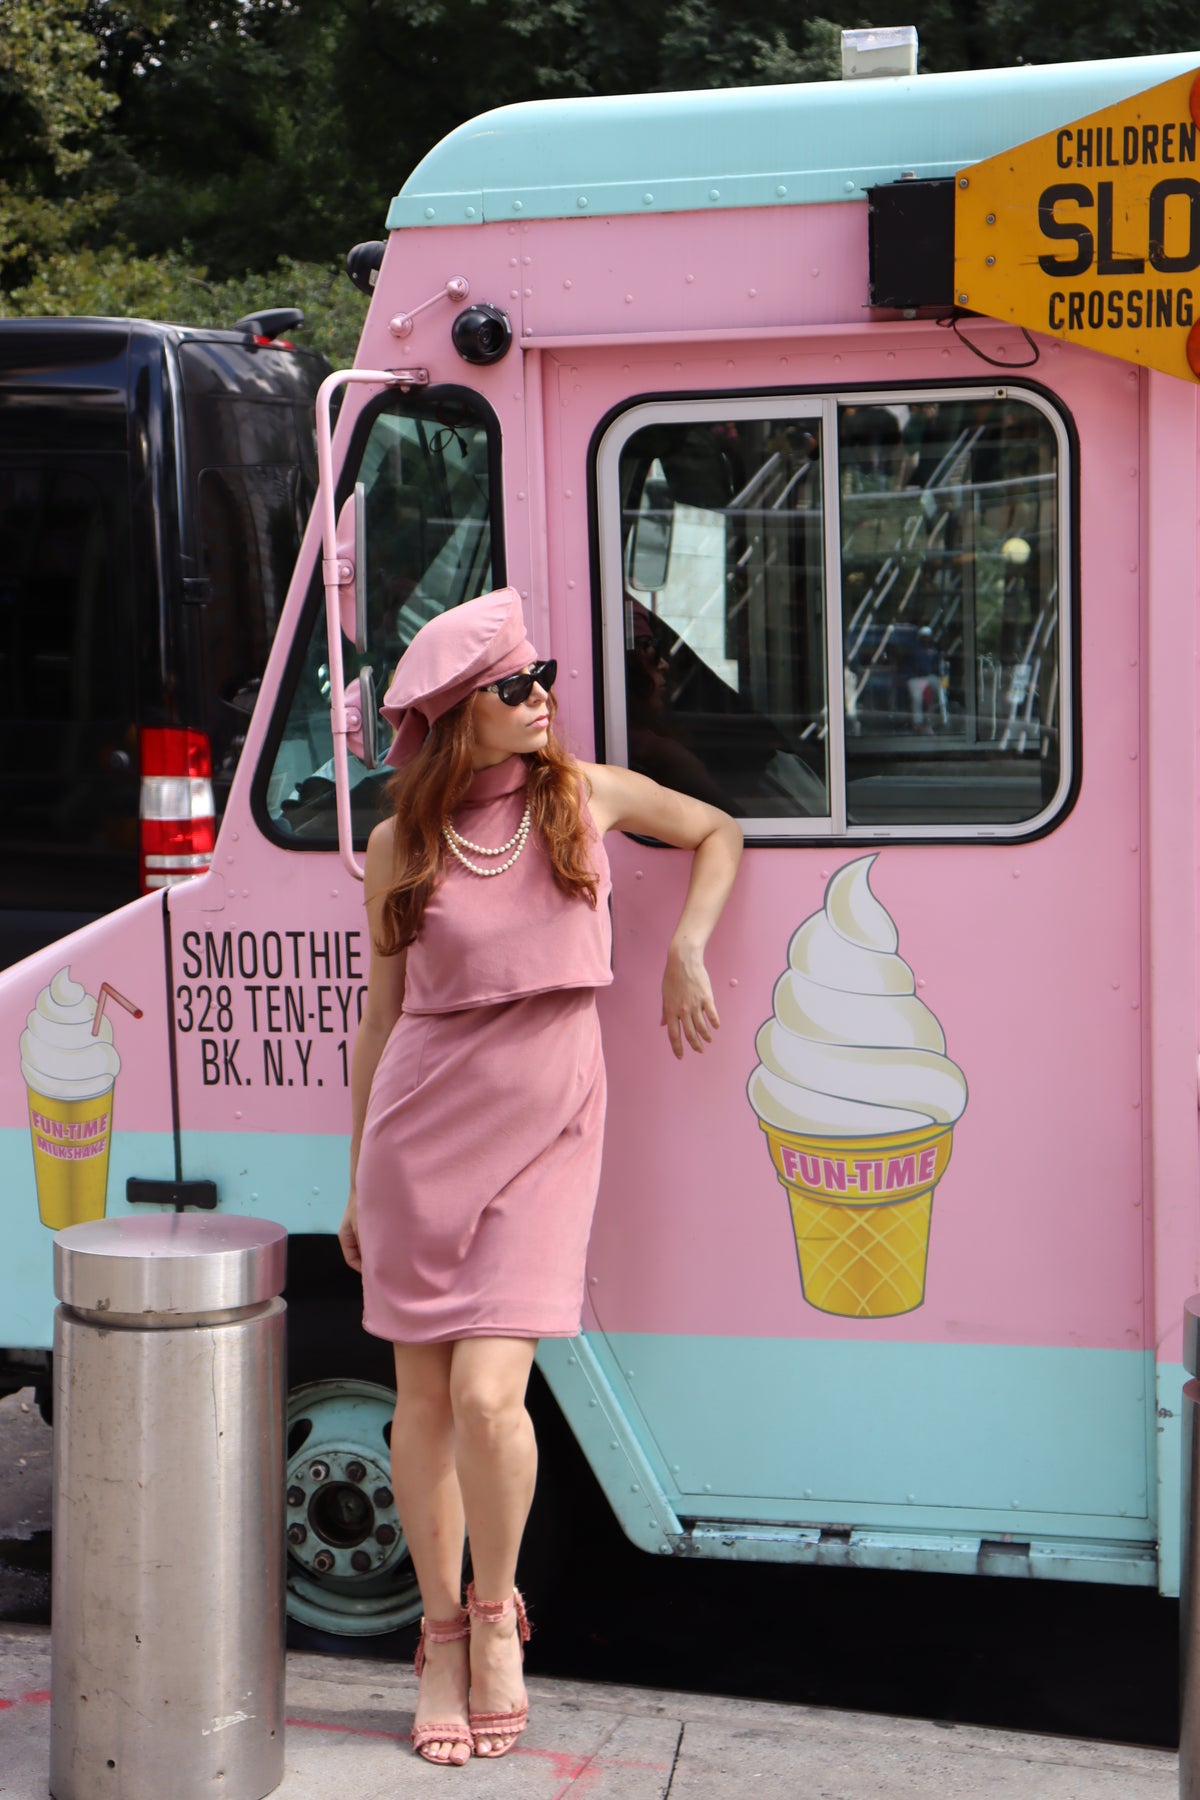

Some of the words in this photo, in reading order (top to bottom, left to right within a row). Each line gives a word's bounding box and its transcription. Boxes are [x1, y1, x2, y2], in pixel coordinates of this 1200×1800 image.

[1056, 122, 1196, 169] CHILDREN
[1037, 177, 1200, 278] SLO
[1048, 288, 1194, 330] CROSSING
[182, 930, 363, 979] SMOOTHIE
[176, 985, 234, 1032] 328
[201, 1038, 252, 1086] BK.
[263, 1039, 323, 1087] N.Y.
[31, 1109, 108, 1141] FUN-TIME
[36, 1134, 107, 1160] MILKSHAKE
[780, 1146, 938, 1193] FUN-TIME
